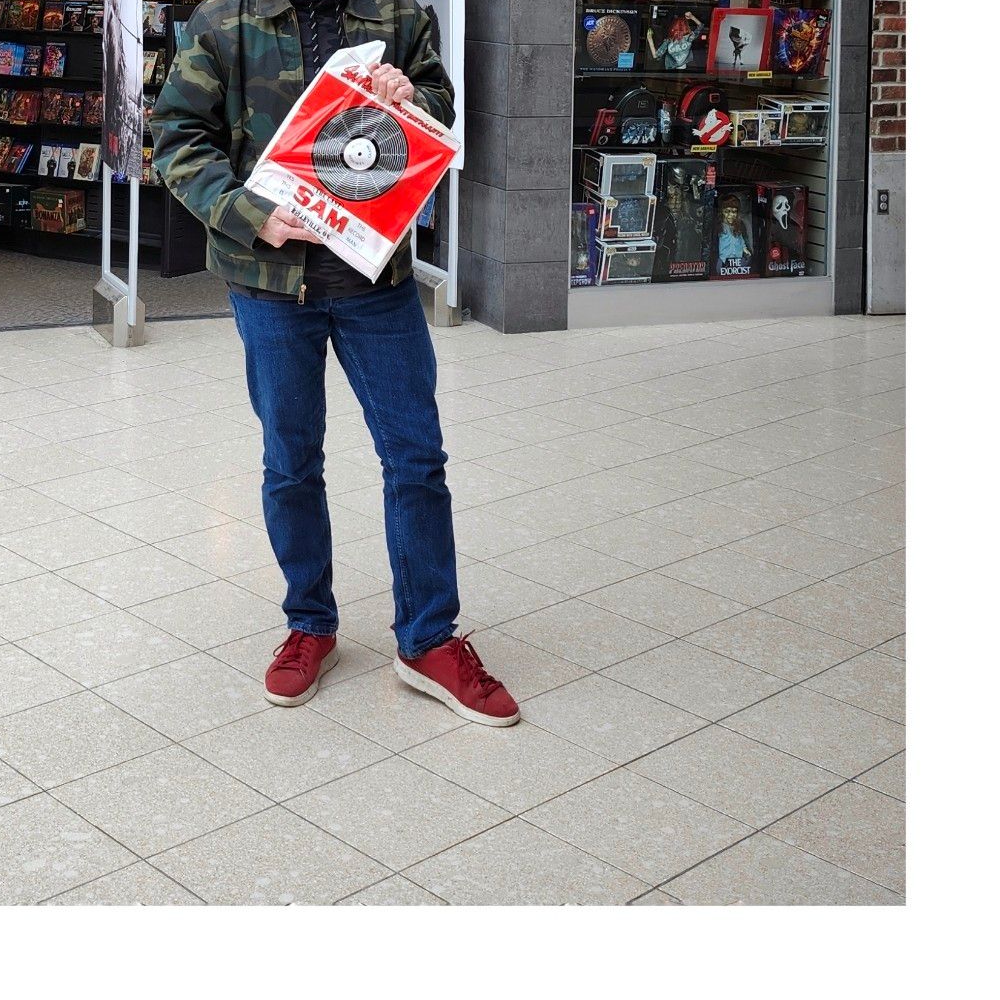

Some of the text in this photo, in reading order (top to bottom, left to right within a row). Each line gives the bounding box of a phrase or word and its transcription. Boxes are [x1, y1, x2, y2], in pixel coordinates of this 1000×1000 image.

[293, 185, 349, 234] SAM
[728, 259, 742, 267] THE
[768, 260, 805, 273] Ghost Face
[720, 267, 751, 276] EXORCIST
